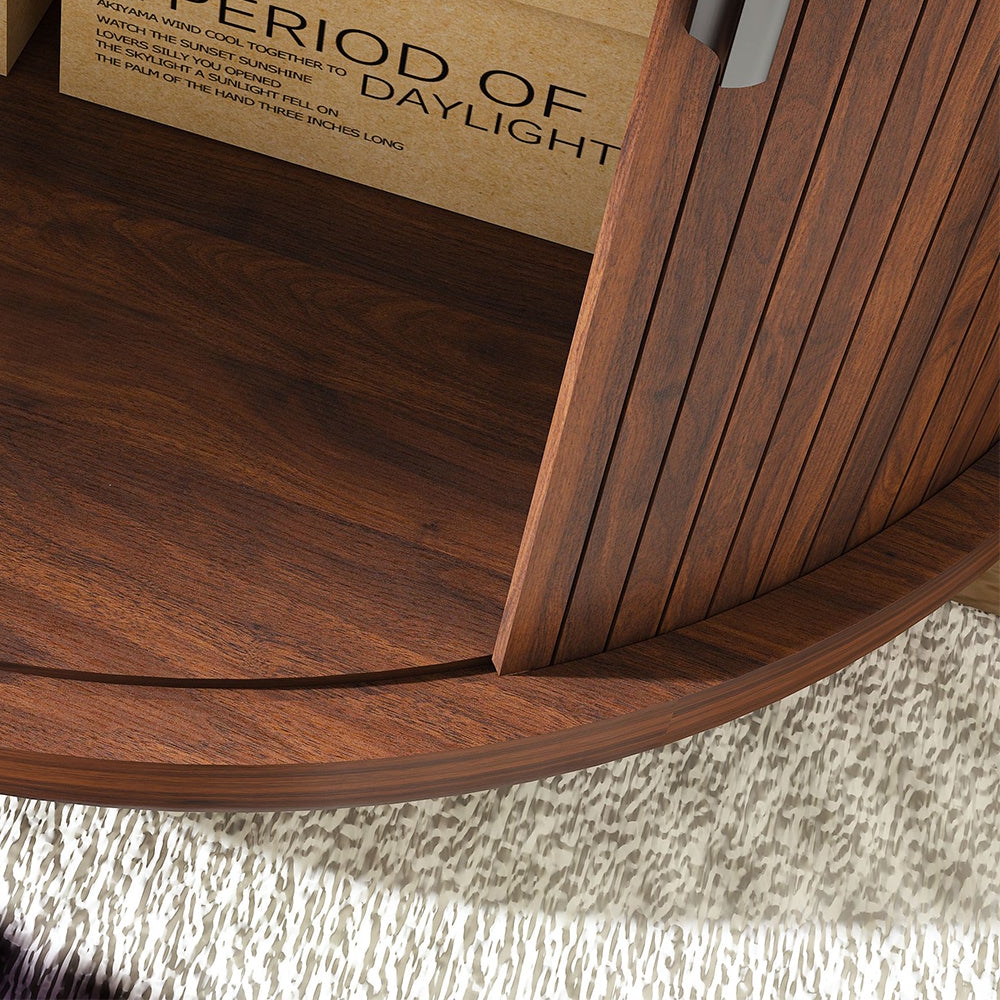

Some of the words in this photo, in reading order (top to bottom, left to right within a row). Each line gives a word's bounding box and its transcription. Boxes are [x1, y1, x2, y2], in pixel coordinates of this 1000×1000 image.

[96, 28, 149, 50] LOVERS
[152, 45, 189, 61] SILLY
[192, 56, 221, 71] YOU
[225, 66, 281, 88] OPENED
[97, 0, 159, 22] AKIYAMA
[161, 16, 201, 34] WIND
[205, 30, 244, 48] COOL
[248, 41, 323, 70] TOGETHER
[327, 64, 347, 77] TO
[97, 14, 146, 35] WATCH
[149, 29, 177, 44] THE
[180, 39, 236, 60] SUNSET
[239, 56, 313, 84] SUNSHINE
[95, 53, 121, 67] THE
[125, 62, 159, 78] PALM
[163, 73, 182, 83] OF
[184, 79, 212, 92] THE
[215, 88, 255, 106] HAND
[258, 101, 304, 121] THREE
[307, 115, 360, 138] INCHES
[364, 132, 405, 151] LONG
[96, 39, 122, 53] THE
[125, 48, 192, 74] SKYLIGHT
[194, 70, 205, 78] A
[208, 73, 280, 99] SUNLIGHT
[283, 94, 314, 110] FELL
[317, 105, 339, 117] ON
[478, 69, 587, 118] OF
[360, 73, 621, 165] DAYLIGHT
